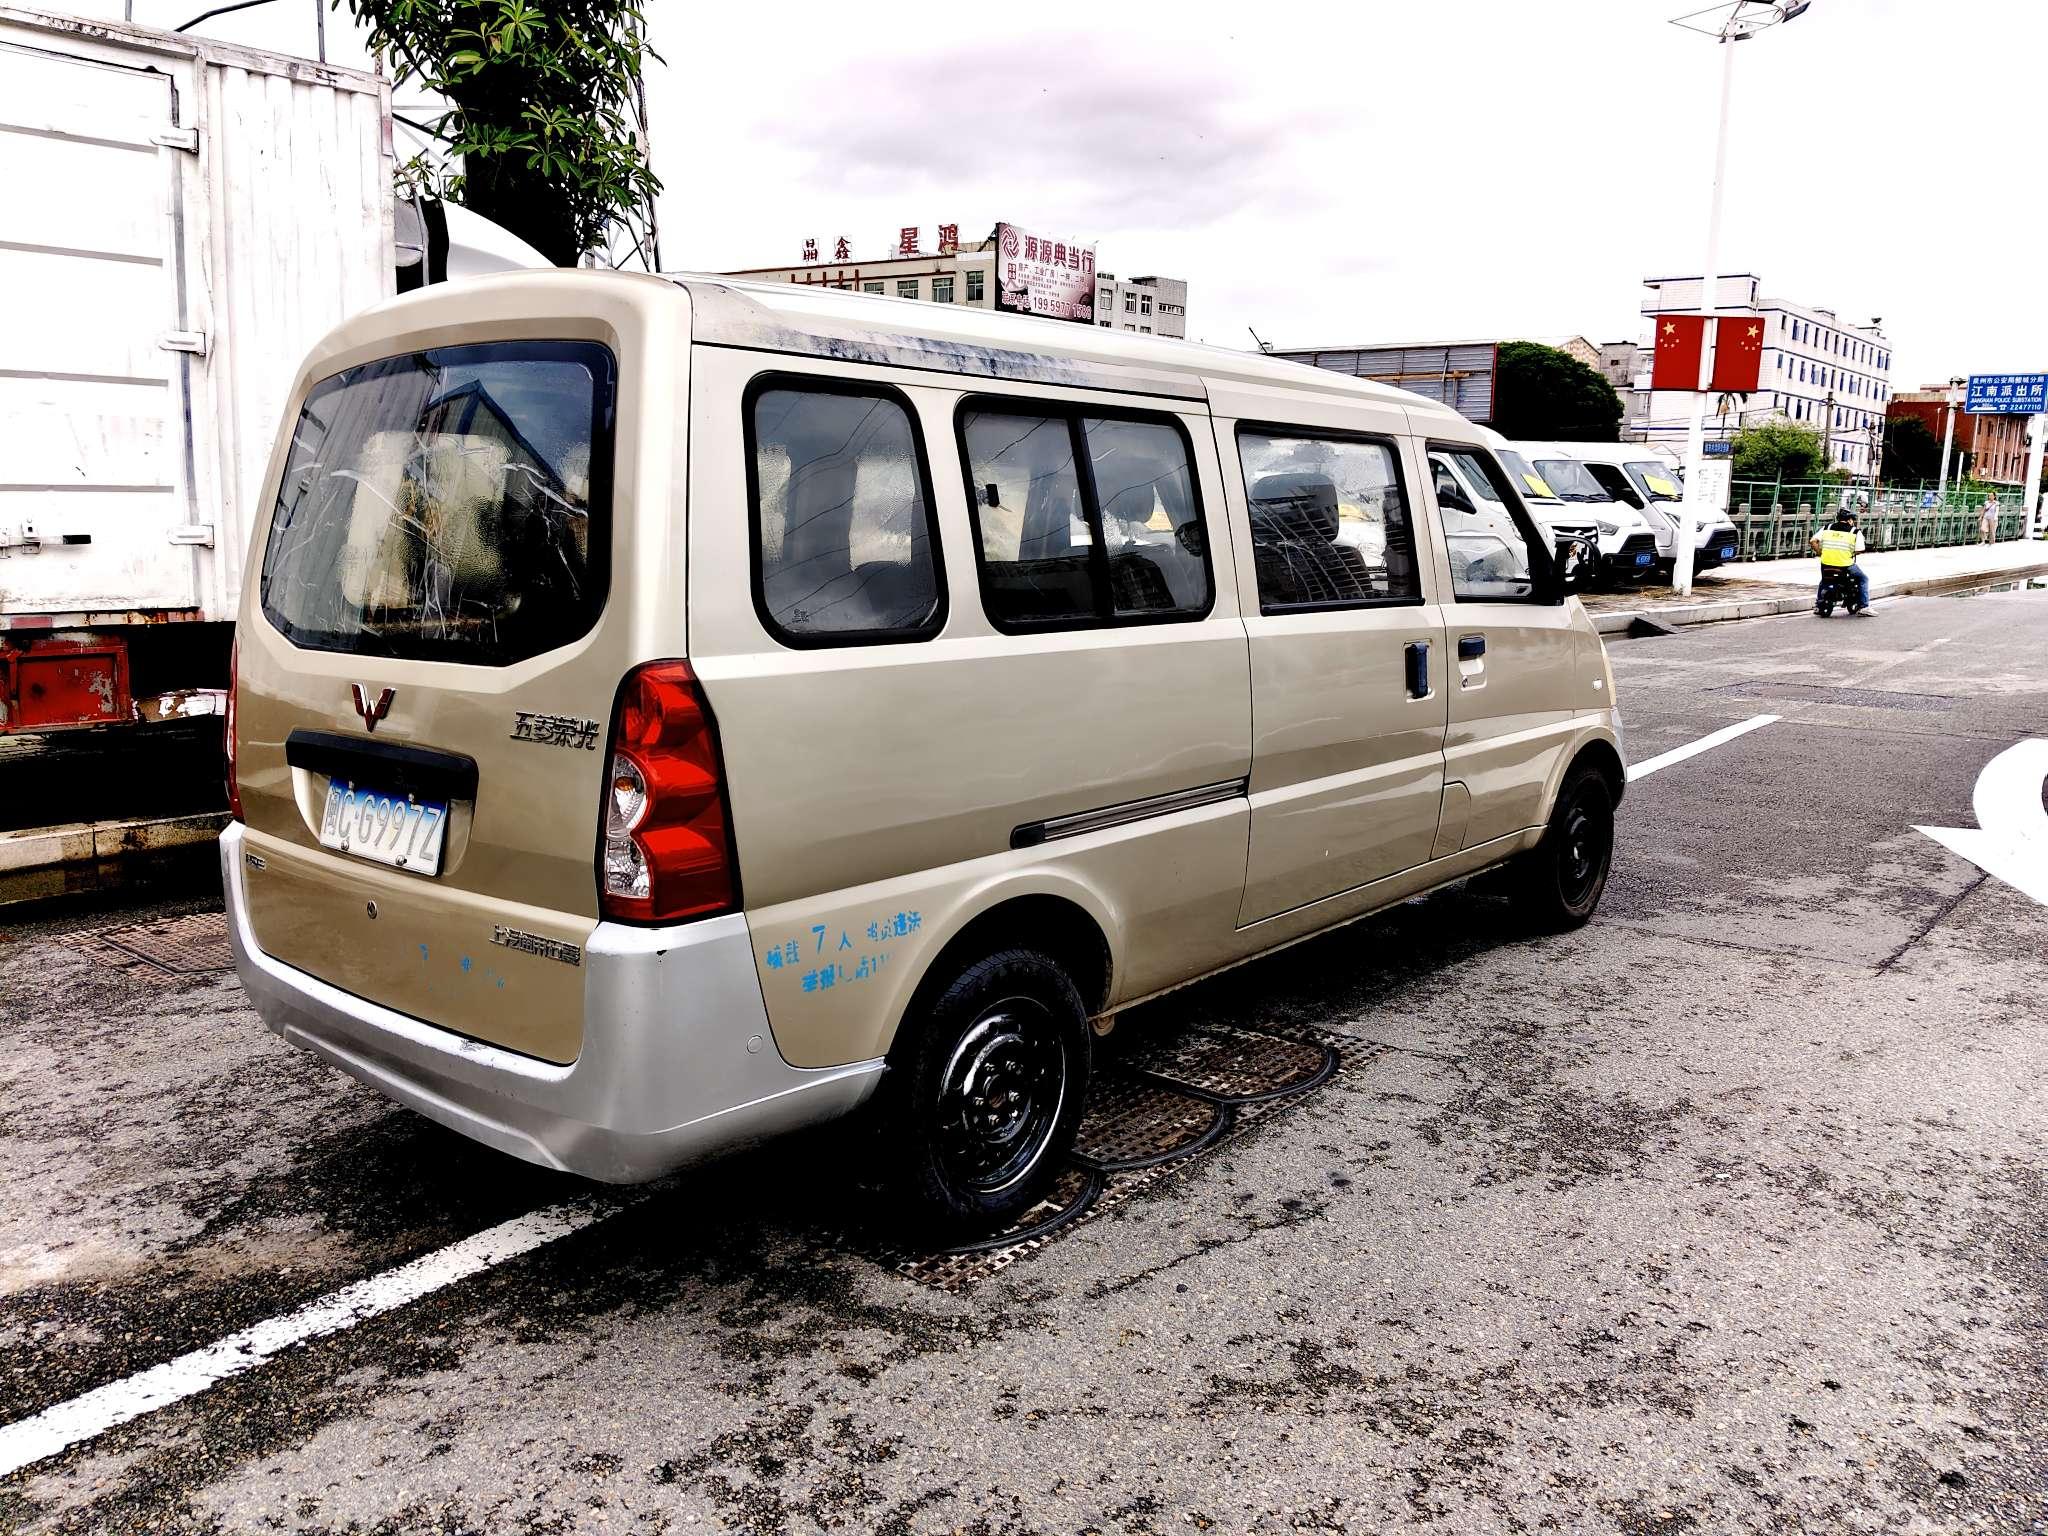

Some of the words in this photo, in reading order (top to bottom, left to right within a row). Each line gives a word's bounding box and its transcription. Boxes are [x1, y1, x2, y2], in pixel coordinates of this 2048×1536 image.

[803, 236, 850, 261] 晶鑫
[901, 224, 958, 254] 星鸿
[1024, 234, 1094, 274] 源源典当行
[1971, 384, 2043, 397] 江南派出所
[510, 711, 600, 750] 五菱荣光
